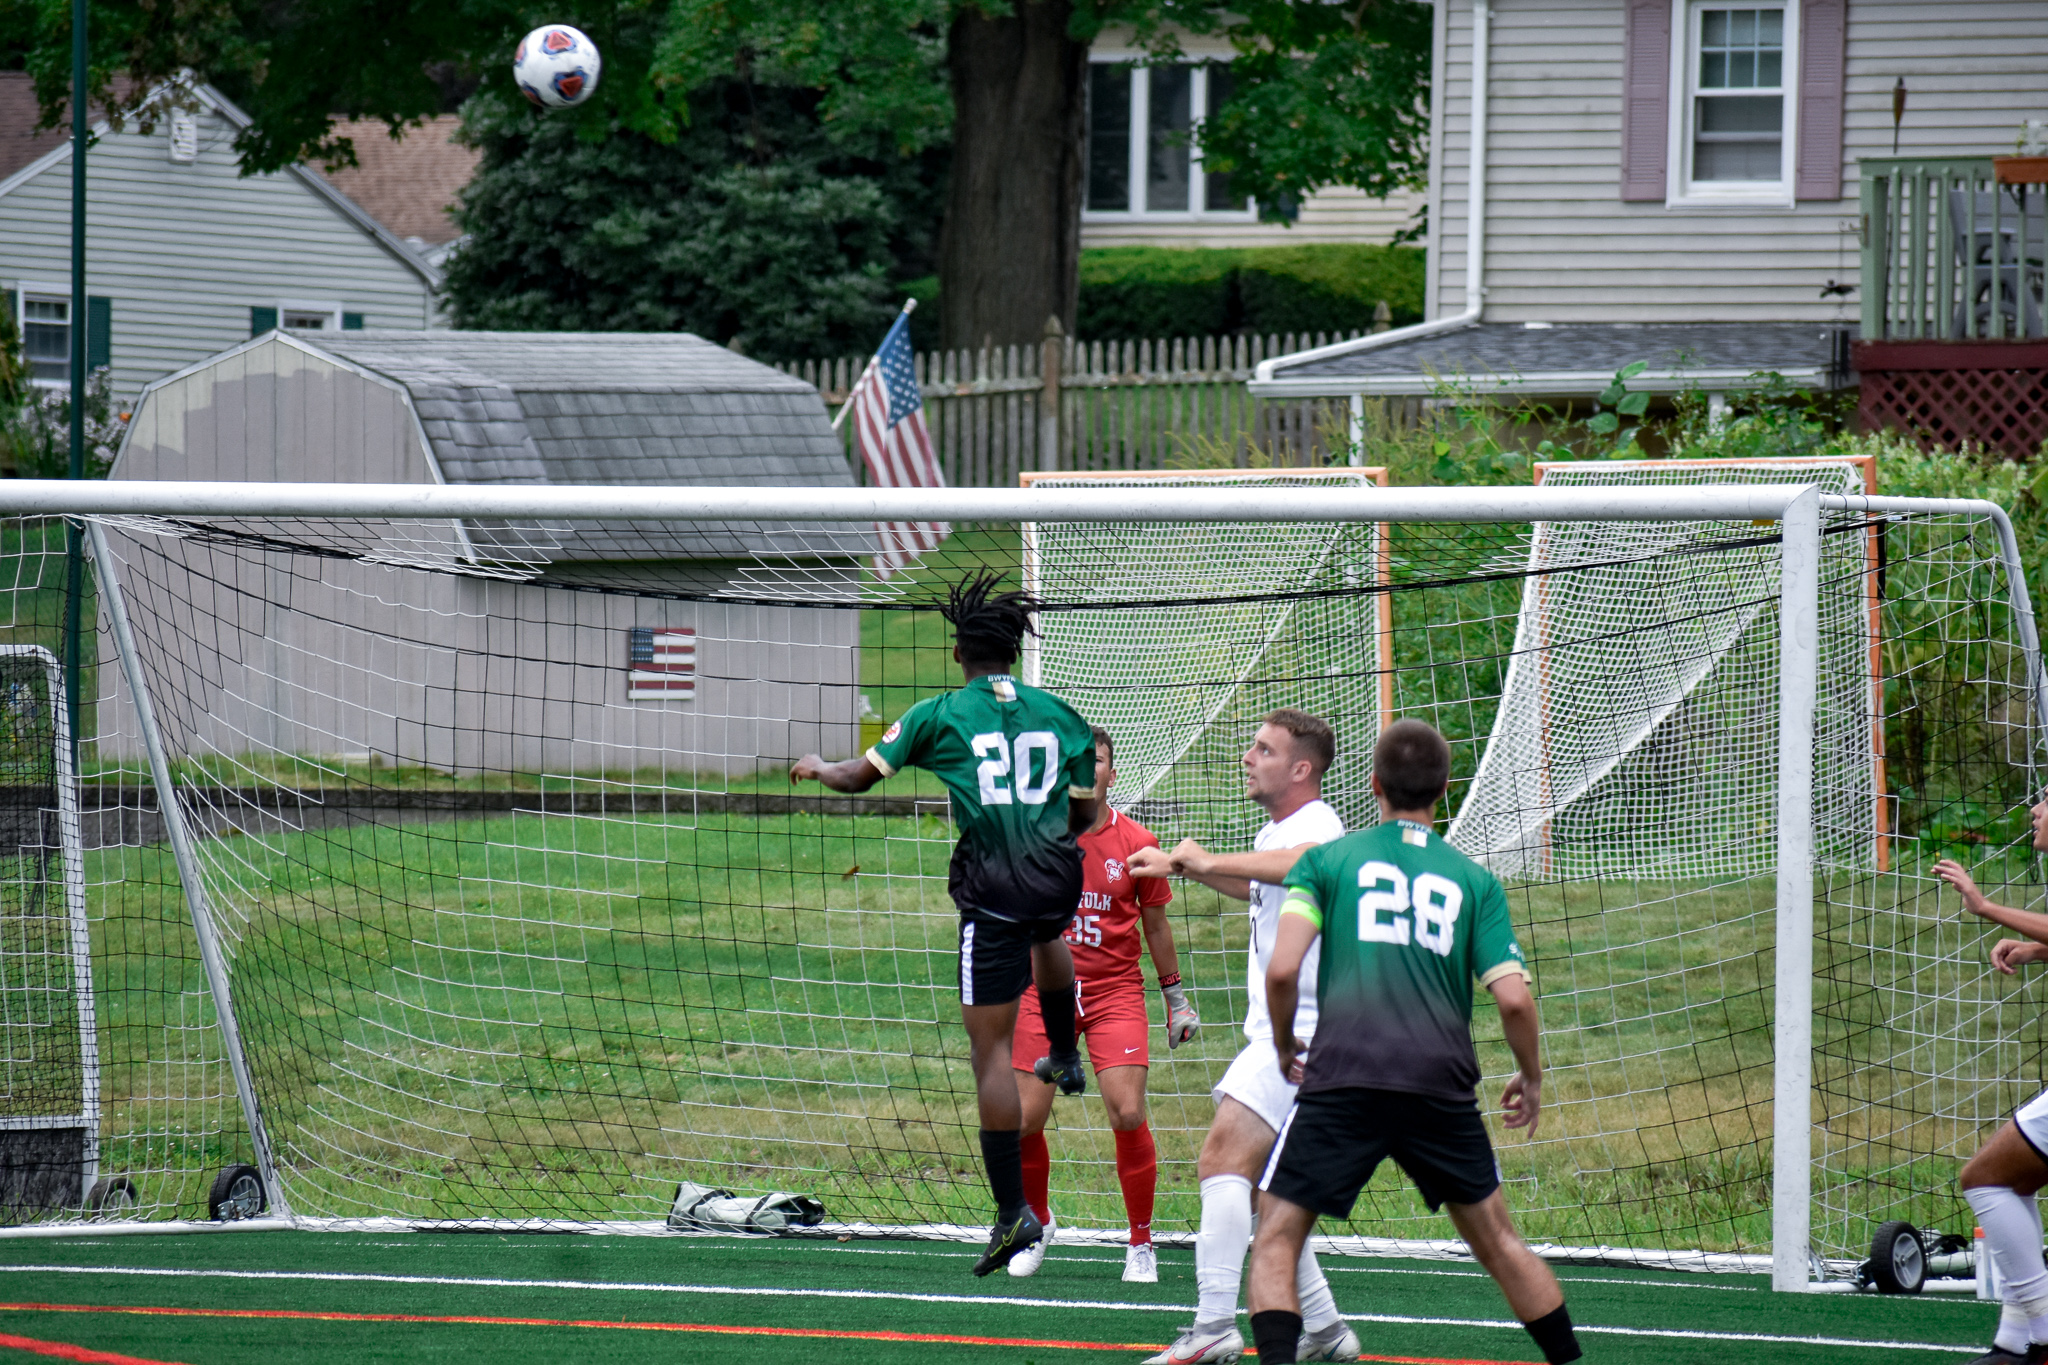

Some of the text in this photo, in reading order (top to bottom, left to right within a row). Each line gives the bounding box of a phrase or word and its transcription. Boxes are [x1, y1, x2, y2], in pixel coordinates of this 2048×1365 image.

[971, 731, 1059, 805] 20
[1077, 891, 1112, 911] FOLK
[1357, 860, 1463, 957] 28
[1065, 915, 1102, 948] 35
